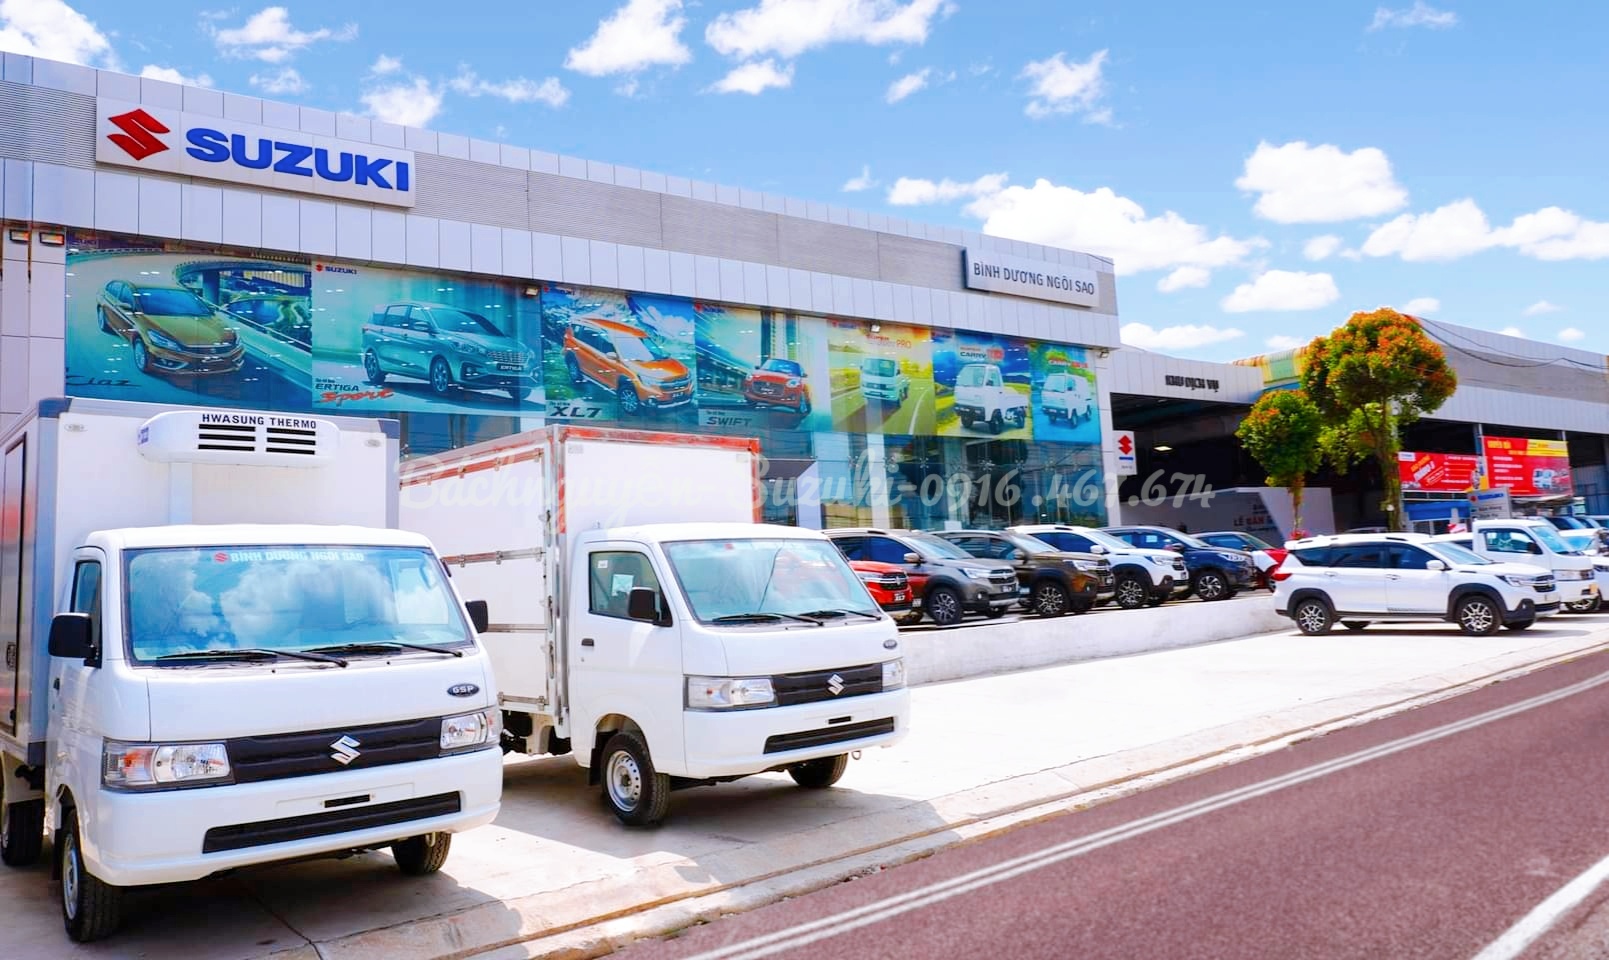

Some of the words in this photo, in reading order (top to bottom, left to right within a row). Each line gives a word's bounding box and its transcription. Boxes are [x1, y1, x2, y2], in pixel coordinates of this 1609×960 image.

[186, 127, 409, 192] SUZUKI
[974, 261, 1000, 279] BÌNH
[1003, 267, 1044, 286] DƯƠNG
[1046, 275, 1073, 291] NGÔI
[1075, 280, 1095, 295] SAO
[315, 383, 360, 392] ERTIGA
[550, 406, 602, 418] XL7
[202, 413, 264, 426] HWASUNG
[269, 417, 317, 429] THERMO
[706, 416, 752, 427] SWIFT
